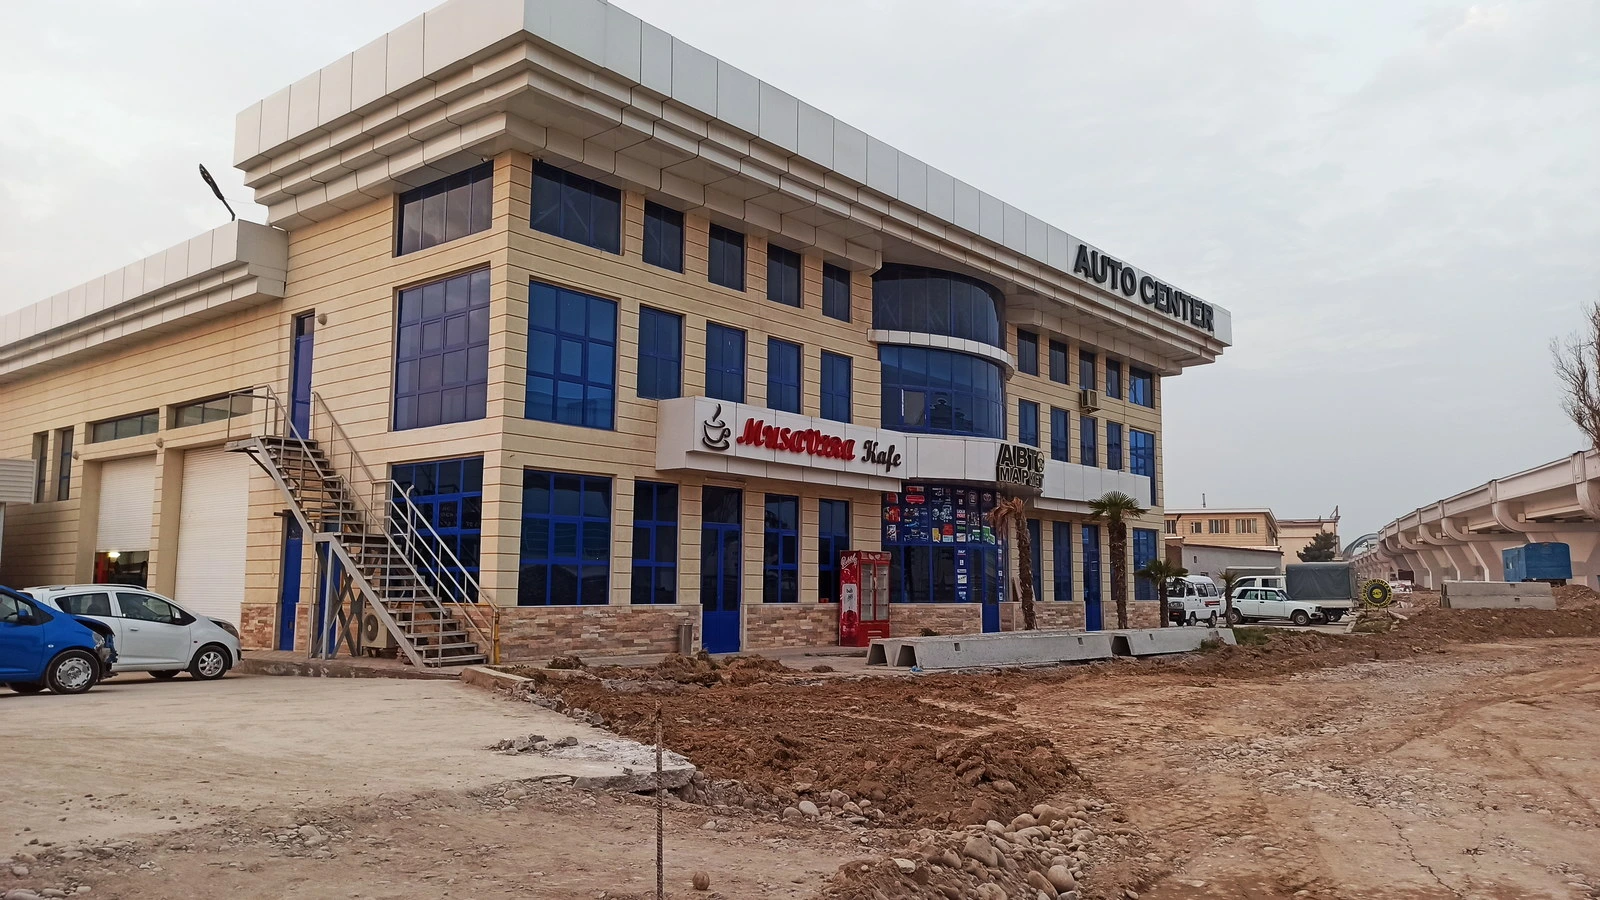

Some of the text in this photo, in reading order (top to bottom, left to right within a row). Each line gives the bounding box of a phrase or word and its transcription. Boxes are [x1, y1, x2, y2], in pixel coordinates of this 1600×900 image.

[1074, 244, 1214, 331] AUTO CENTER
[861, 440, 902, 472] Kafe
